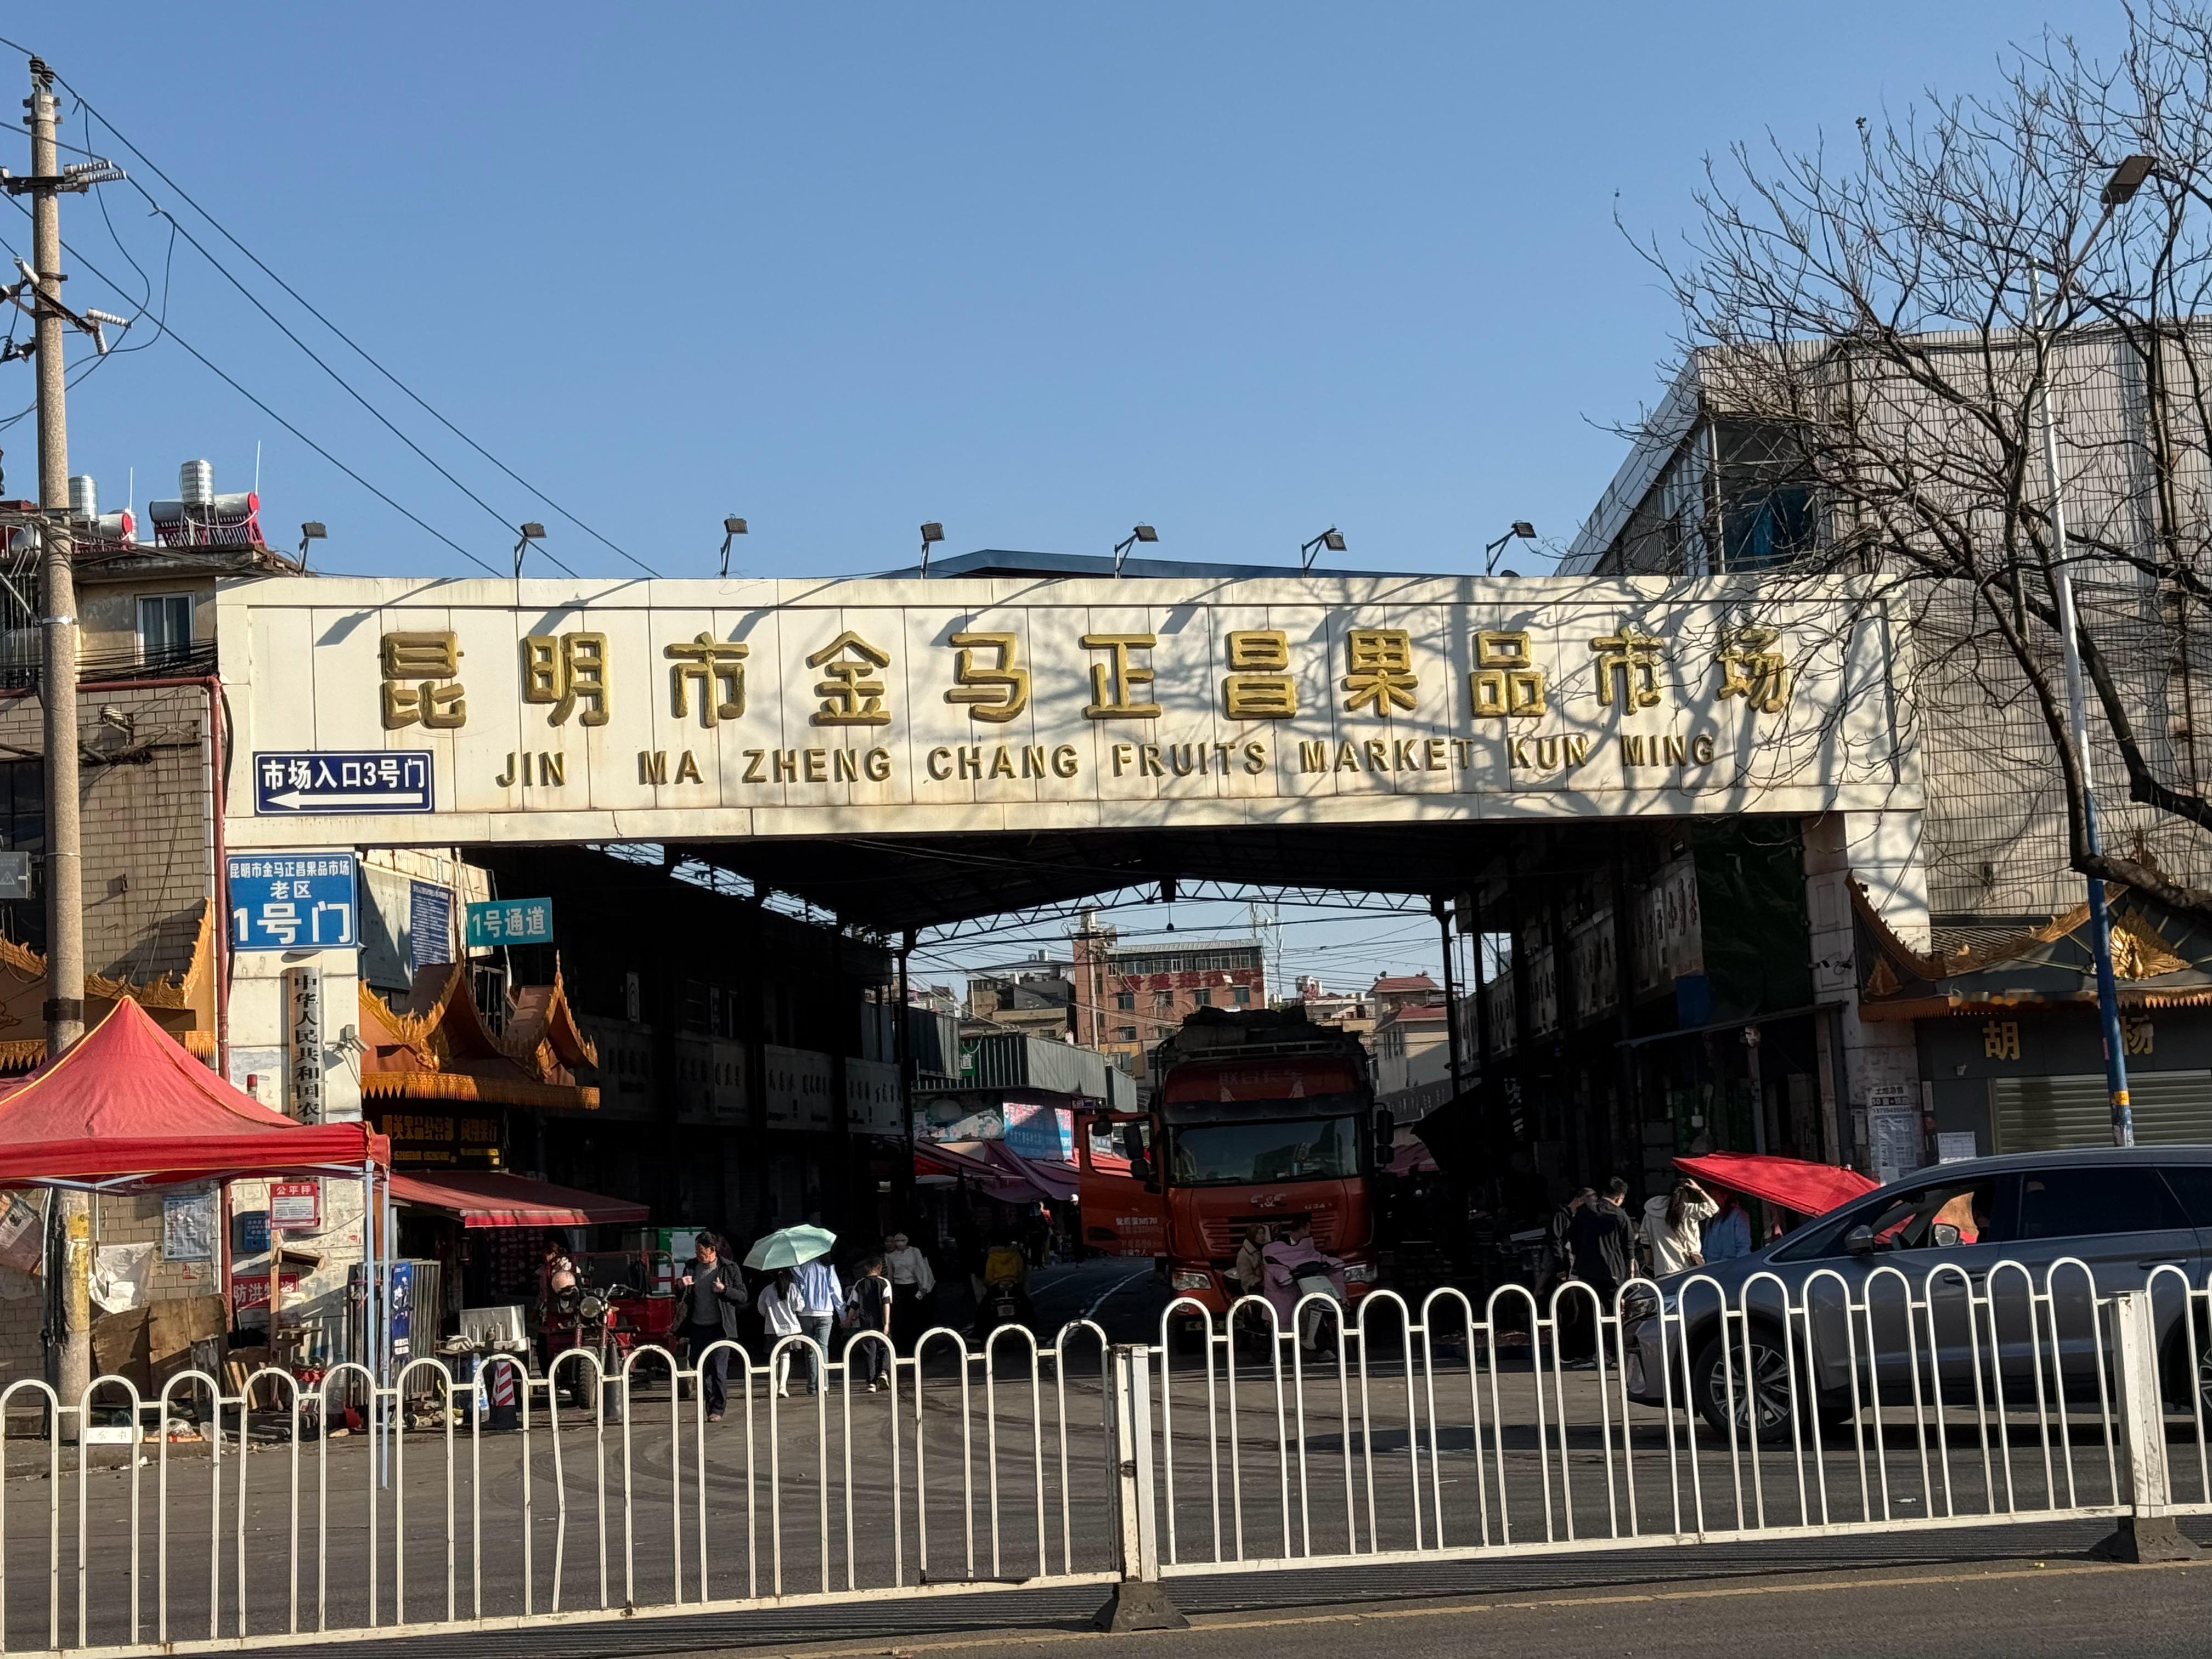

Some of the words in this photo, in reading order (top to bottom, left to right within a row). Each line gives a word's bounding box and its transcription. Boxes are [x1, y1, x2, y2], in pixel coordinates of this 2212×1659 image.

[381, 627, 1788, 731] 昆明市金马正昌果品市场
[261, 758, 426, 791] 市场入口3号门
[495, 750, 566, 788] JIN
[637, 749, 705, 785] MA
[741, 746, 893, 783] ZHENG
[926, 744, 1079, 781] CHANG
[1112, 740, 1267, 777] FRUITS
[1299, 736, 1474, 774] MARKET
[1508, 734, 1588, 769] KUN
[1620, 734, 1716, 768] MING
[229, 859, 351, 879] 昆明市金马正昌果品市场
[269, 881, 312, 900] 老区
[233, 902, 352, 945] 1号门
[472, 907, 547, 938] 1号通道
[294, 974, 321, 1125] 中华人民共和国农
[276, 1185, 312, 1195] 公平秤
